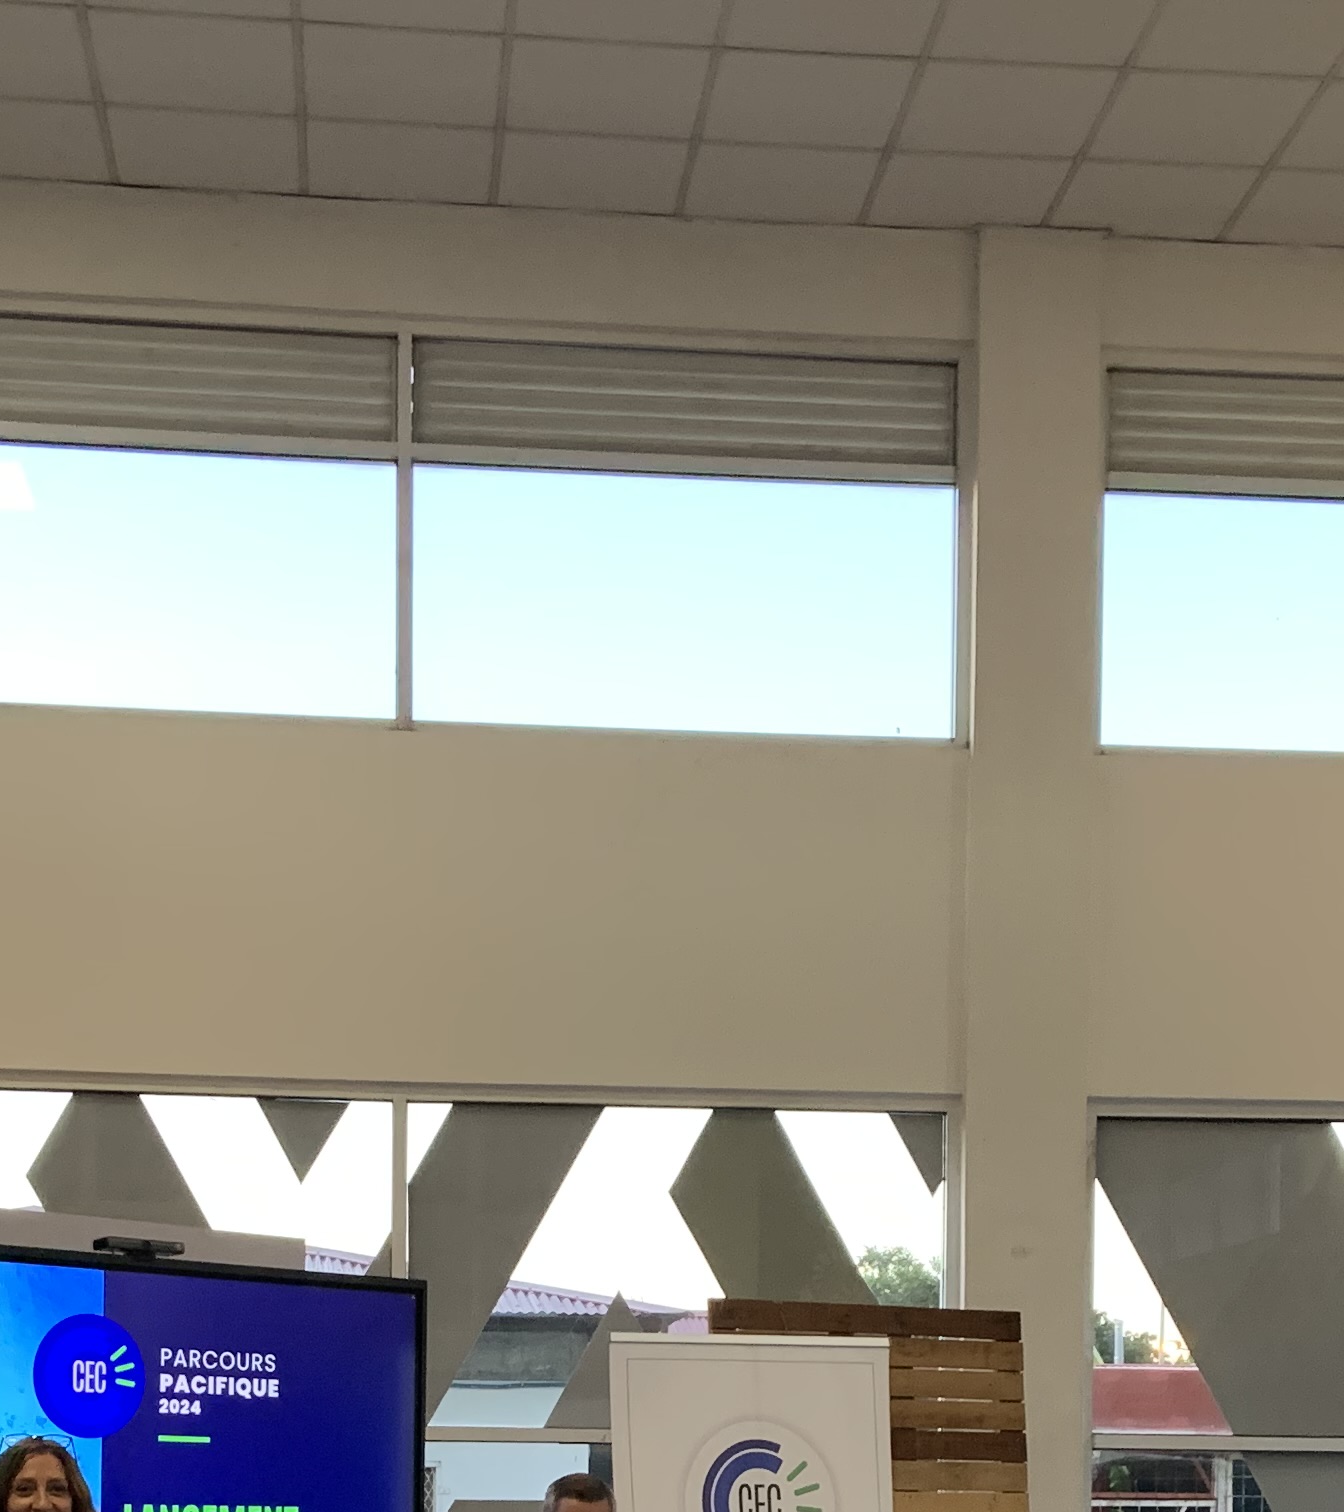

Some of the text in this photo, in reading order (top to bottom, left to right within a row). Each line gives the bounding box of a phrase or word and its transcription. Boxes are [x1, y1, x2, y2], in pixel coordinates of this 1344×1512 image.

[159, 1347, 277, 1373] PARCOURS
[72, 1359, 107, 1394] CEC
[158, 1373, 280, 1400] PACIFIQUE
[158, 1398, 202, 1415] 2024
